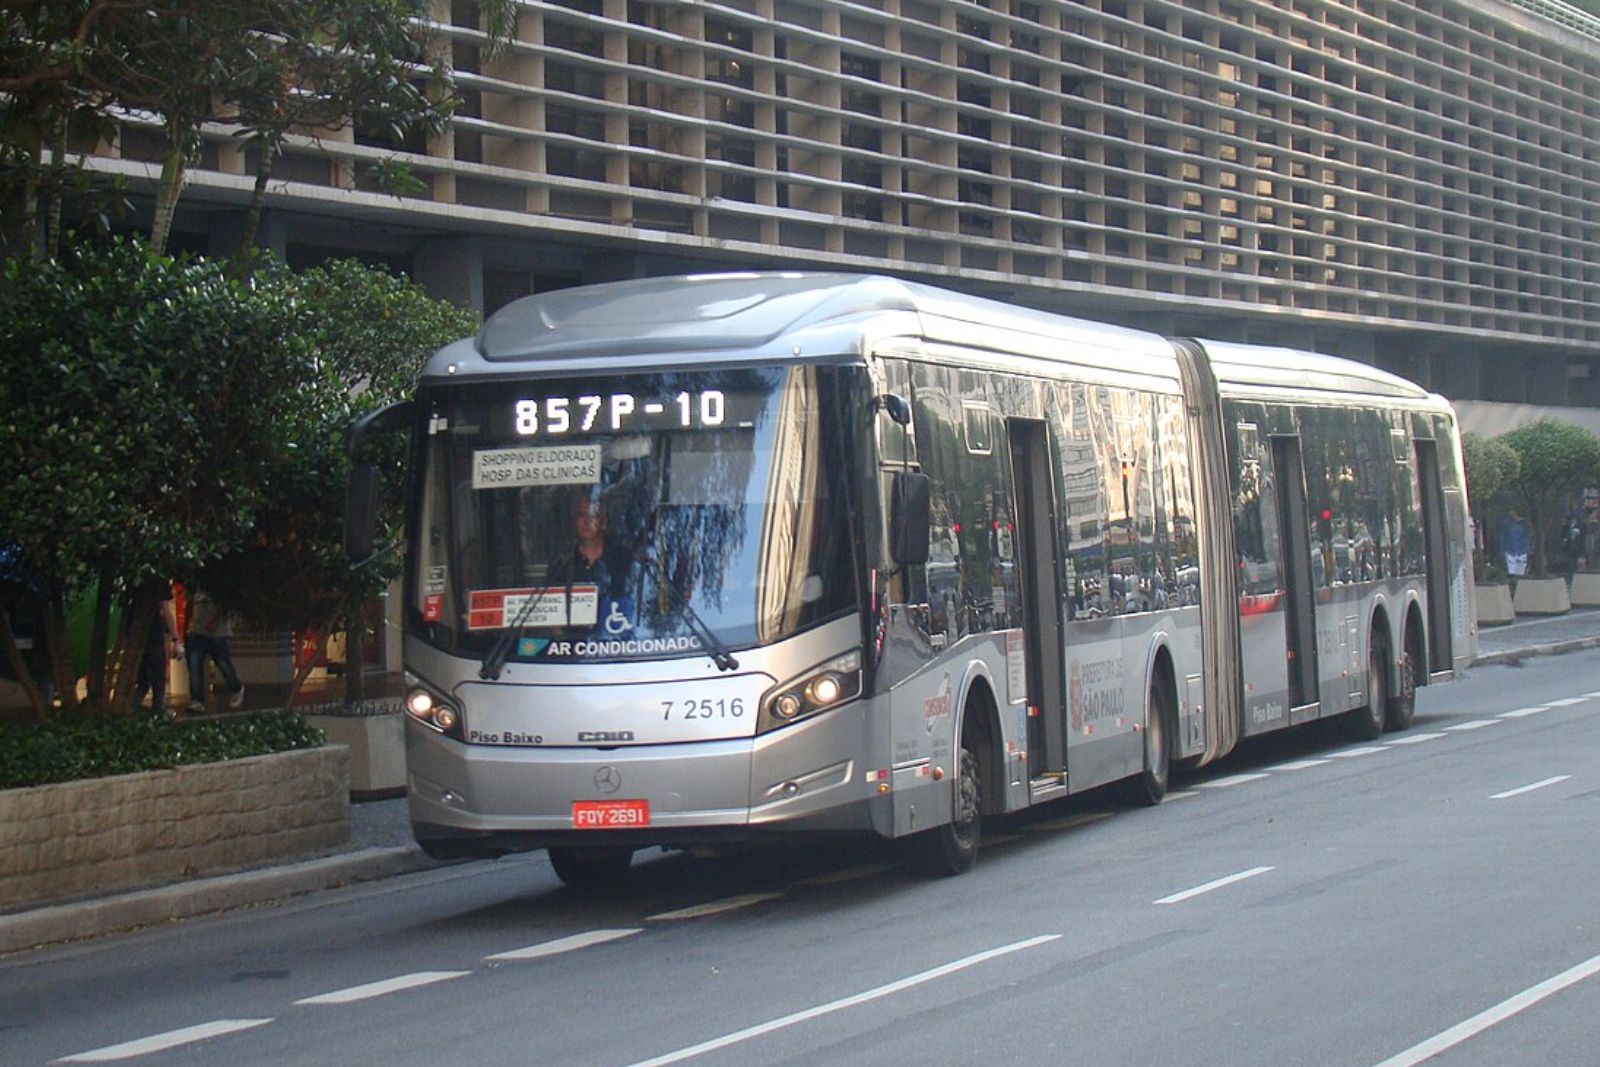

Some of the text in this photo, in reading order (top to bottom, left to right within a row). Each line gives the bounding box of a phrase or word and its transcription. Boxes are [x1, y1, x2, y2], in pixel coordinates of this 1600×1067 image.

[481, 448, 596, 467] SHOPPING ELDORADO
[516, 467, 540, 480] DAS
[547, 635, 701, 656] AR CONDICIONADO
[661, 697, 744, 721] 7 2516
[470, 730, 543, 744] Piso Baixo
